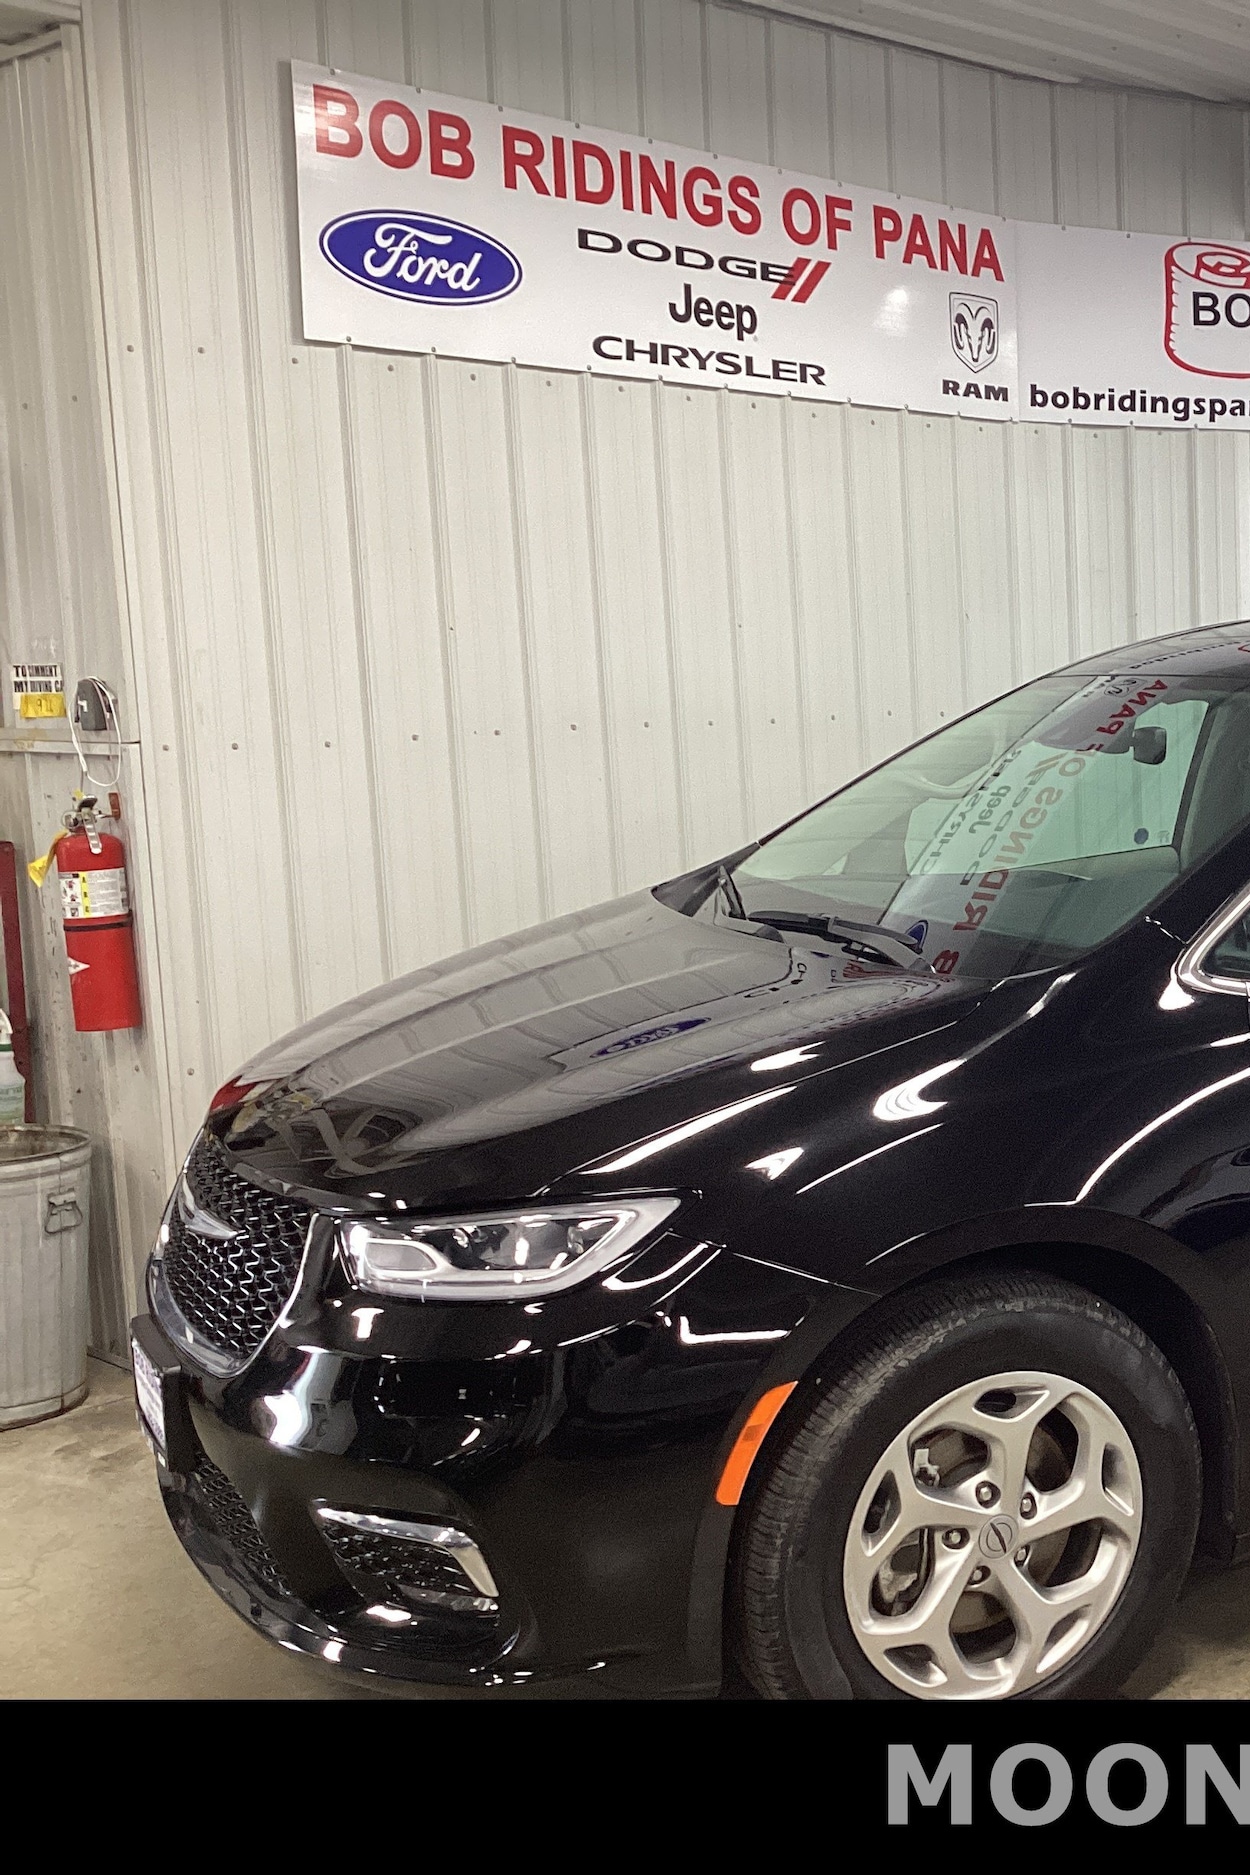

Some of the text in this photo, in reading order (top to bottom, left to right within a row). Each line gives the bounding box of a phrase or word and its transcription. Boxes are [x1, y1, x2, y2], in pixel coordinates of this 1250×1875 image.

[312, 84, 1006, 283] BOB RIDINGS OF PANA
[363, 223, 483, 291] Ford
[576, 228, 800, 286] DODGE
[668, 283, 759, 342] Jeep
[592, 335, 827, 387] CHRYSLER
[941, 379, 1010, 403] RAM
[13, 665, 27, 677] TO
